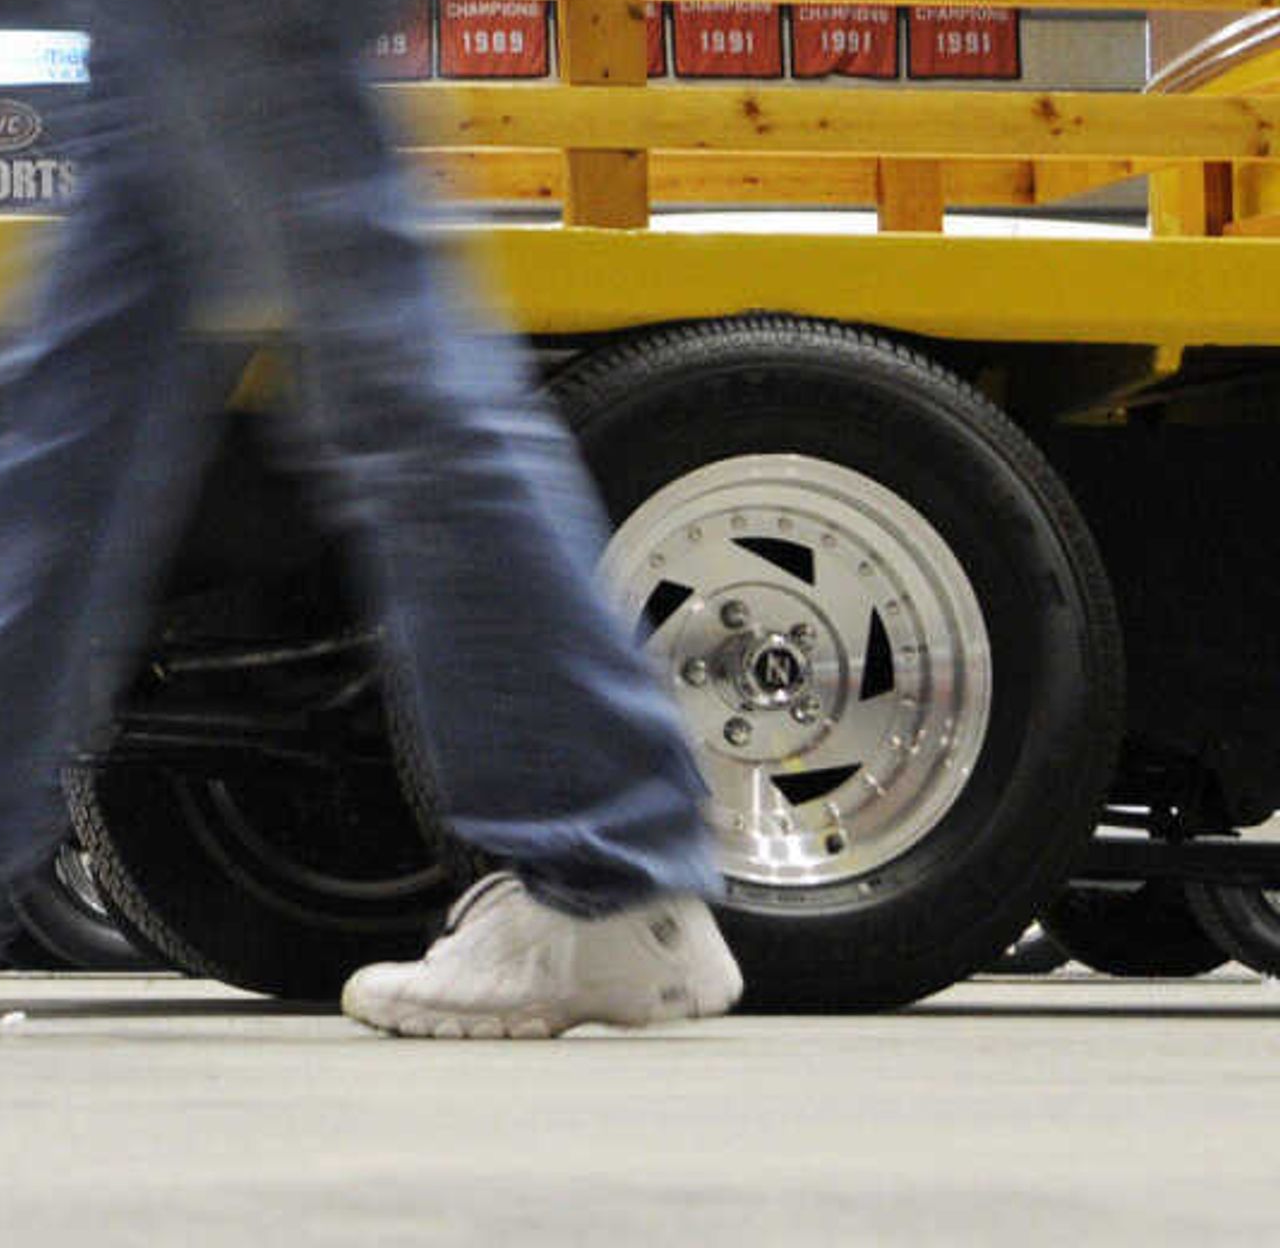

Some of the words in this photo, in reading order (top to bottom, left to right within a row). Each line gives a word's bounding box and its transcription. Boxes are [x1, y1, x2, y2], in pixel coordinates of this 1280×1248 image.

[447, 2, 539, 18] CHAMPIONS
[701, 30, 754, 53] 1991
[820, 29, 872, 52] 1991
[937, 30, 991, 54] 1991
